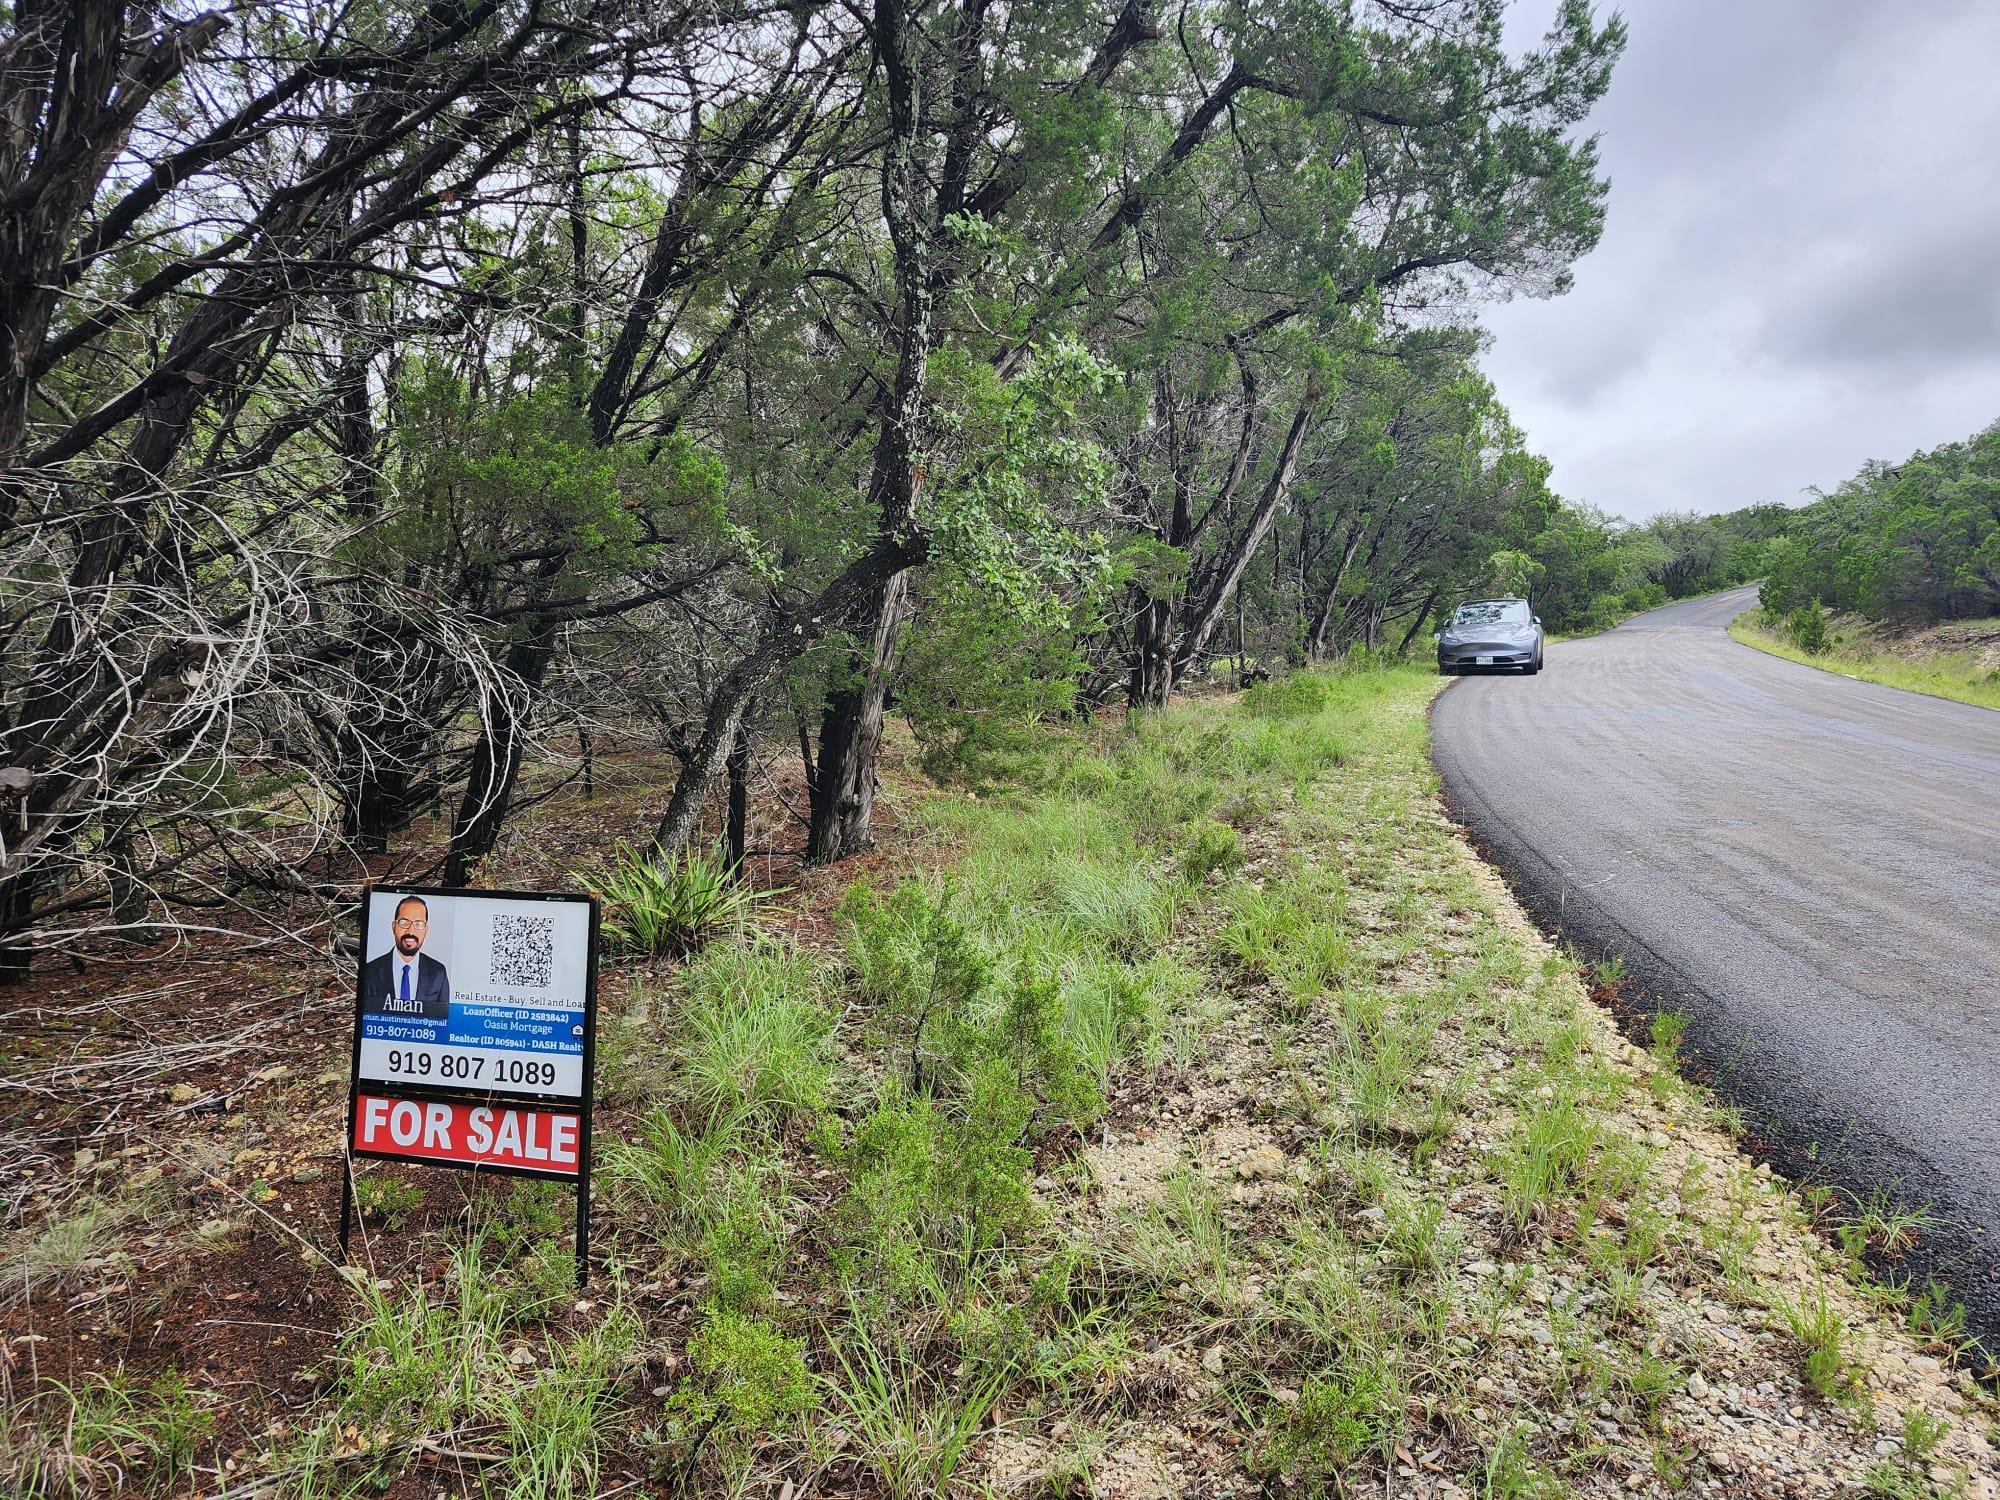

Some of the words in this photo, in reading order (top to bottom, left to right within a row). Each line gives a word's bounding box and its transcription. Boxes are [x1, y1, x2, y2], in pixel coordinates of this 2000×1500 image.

[382, 992, 424, 1013] Aman
[455, 991, 473, 1001] Real
[475, 992, 502, 1003] Estate
[529, 996, 546, 1006] Sell
[547, 997, 564, 1007] and
[463, 1006, 514, 1018] LoanOfficer
[515, 1009, 530, 1021] (ID
[366, 1025, 436, 1041] 919-807-1089
[483, 1019, 508, 1030] Oasis
[510, 1021, 553, 1036] Mortgage
[449, 1033, 480, 1044] Realtor
[480, 1036, 494, 1046] (ID
[531, 1039, 558, 1050] DASH
[388, 1050, 432, 1076] 919
[440, 1054, 485, 1080] 807
[494, 1058, 556, 1086] 1089
[364, 1098, 453, 1150] FOR
[466, 1106, 577, 1163] SALE
